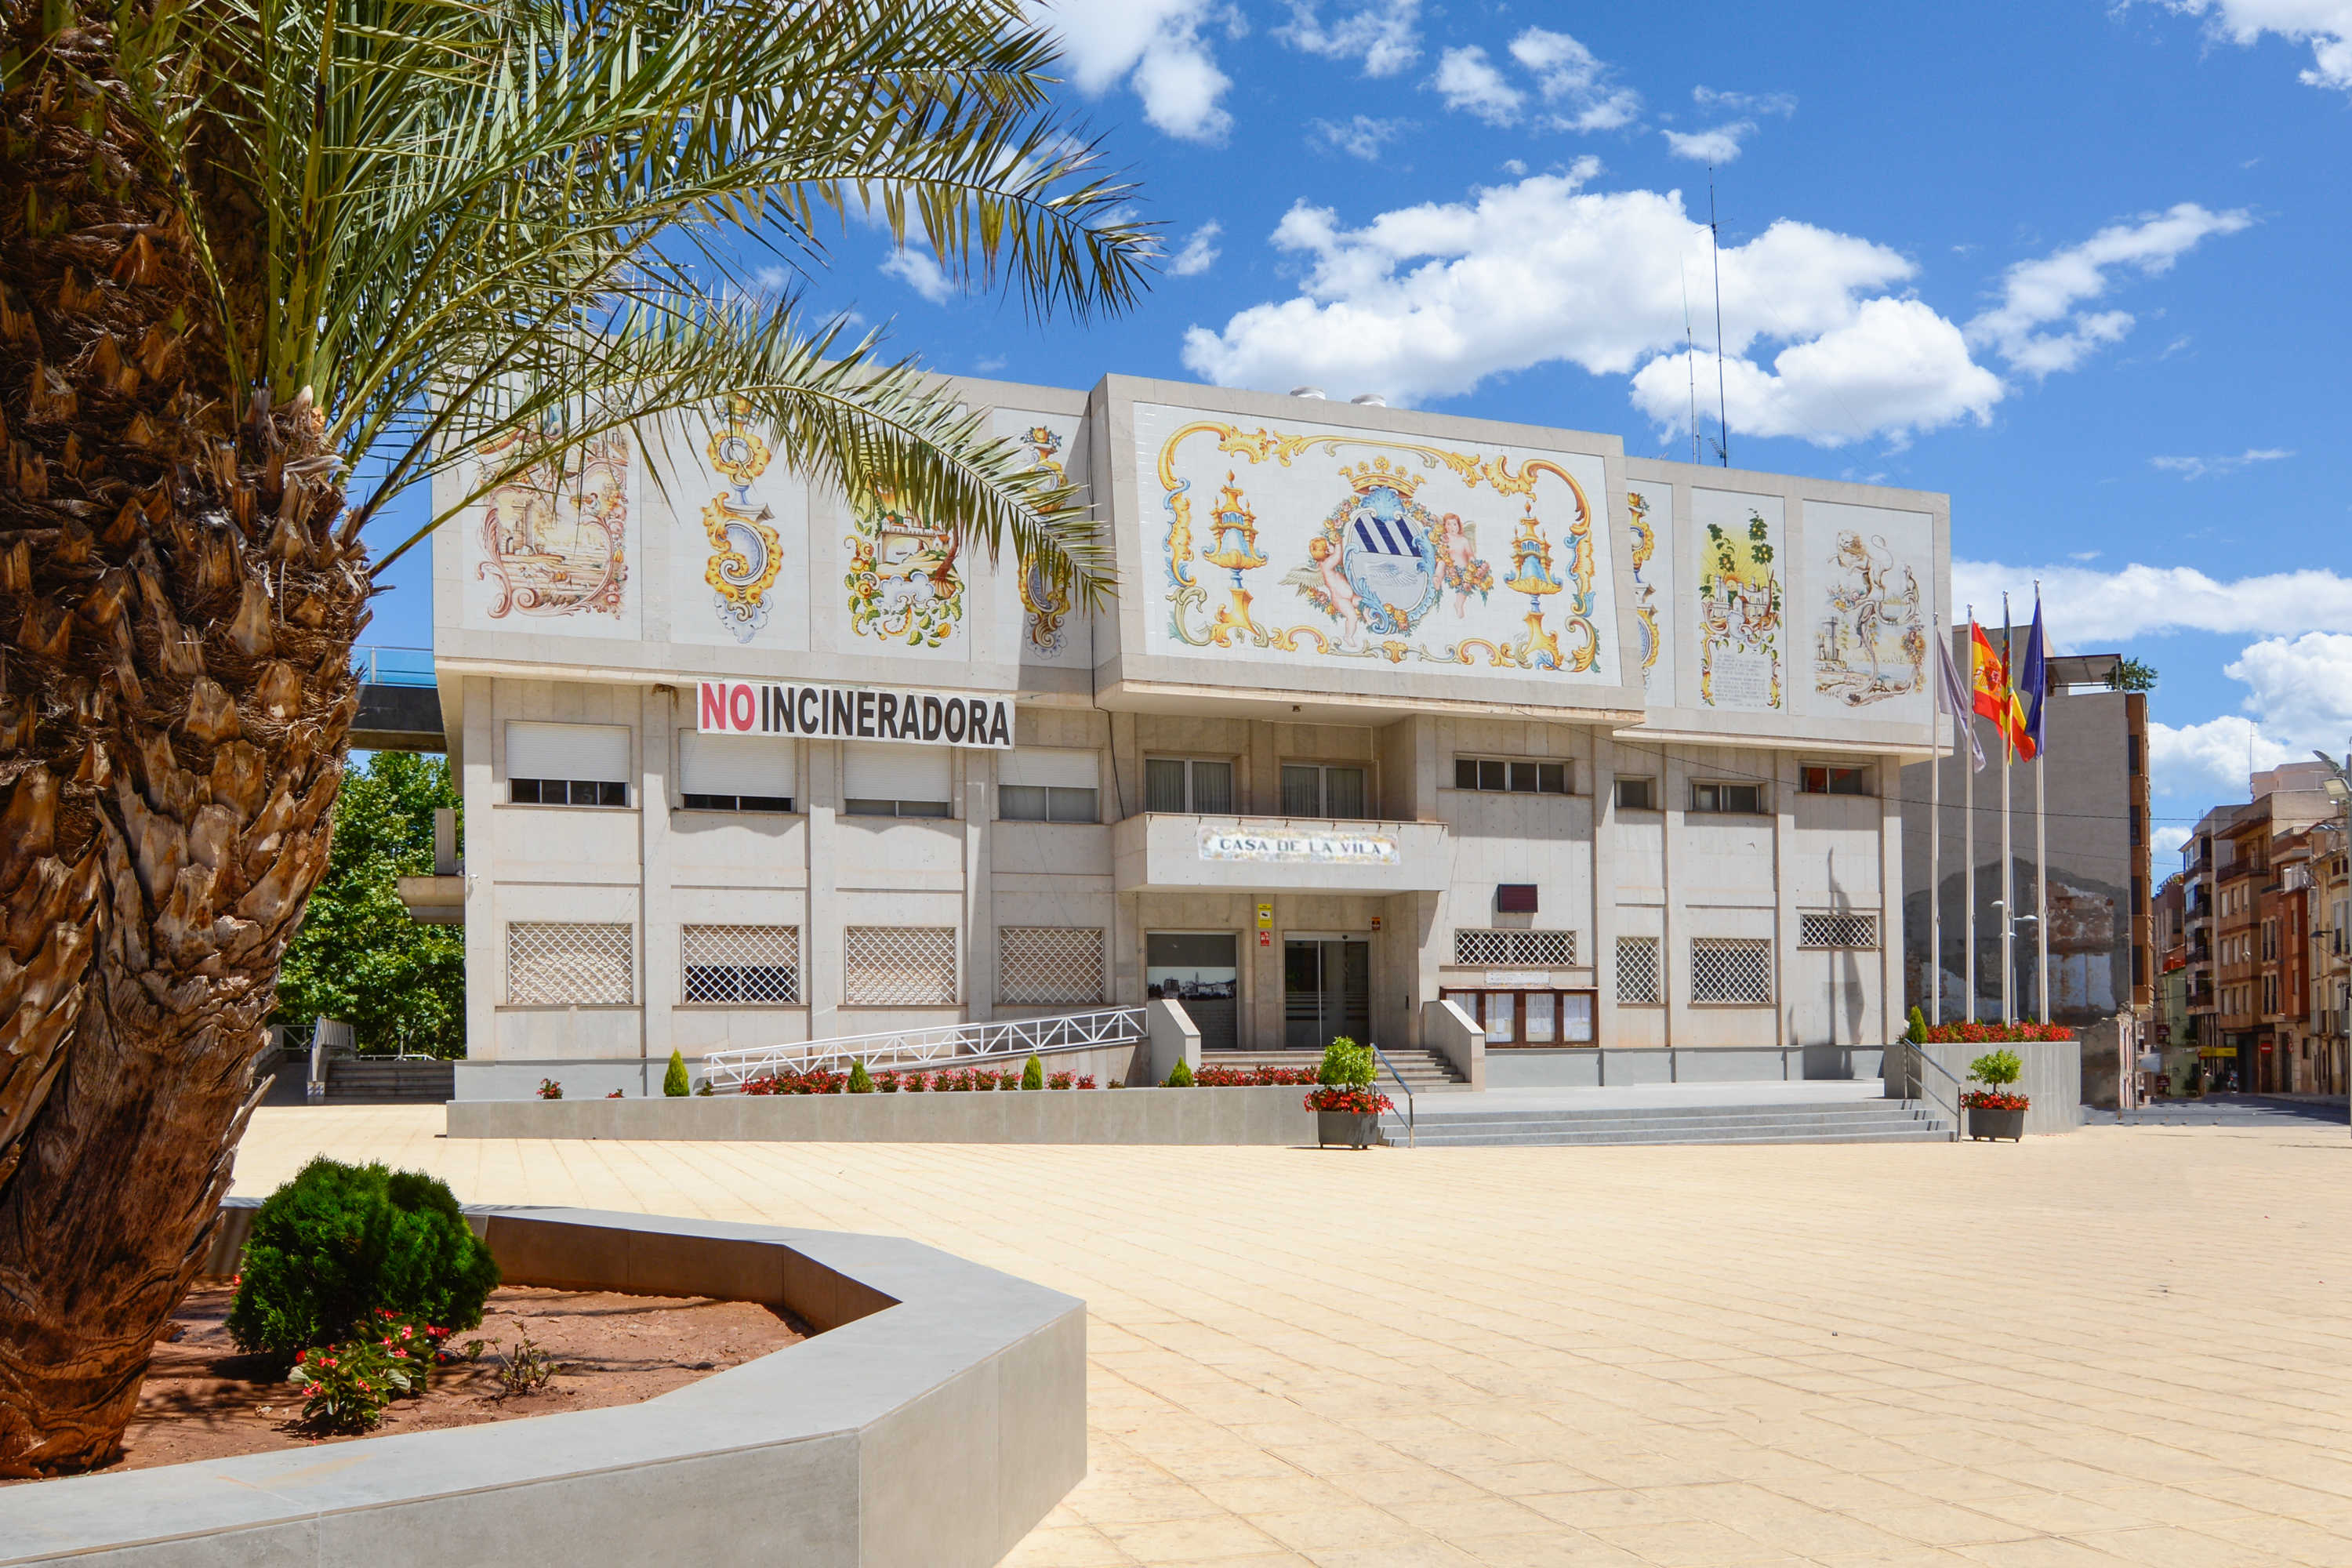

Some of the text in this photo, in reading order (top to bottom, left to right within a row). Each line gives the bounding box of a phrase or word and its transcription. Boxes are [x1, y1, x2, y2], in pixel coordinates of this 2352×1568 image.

[702, 683, 1011, 746] NO INCINERADORA
[1220, 838, 1381, 855] CASA DE LA VILA
